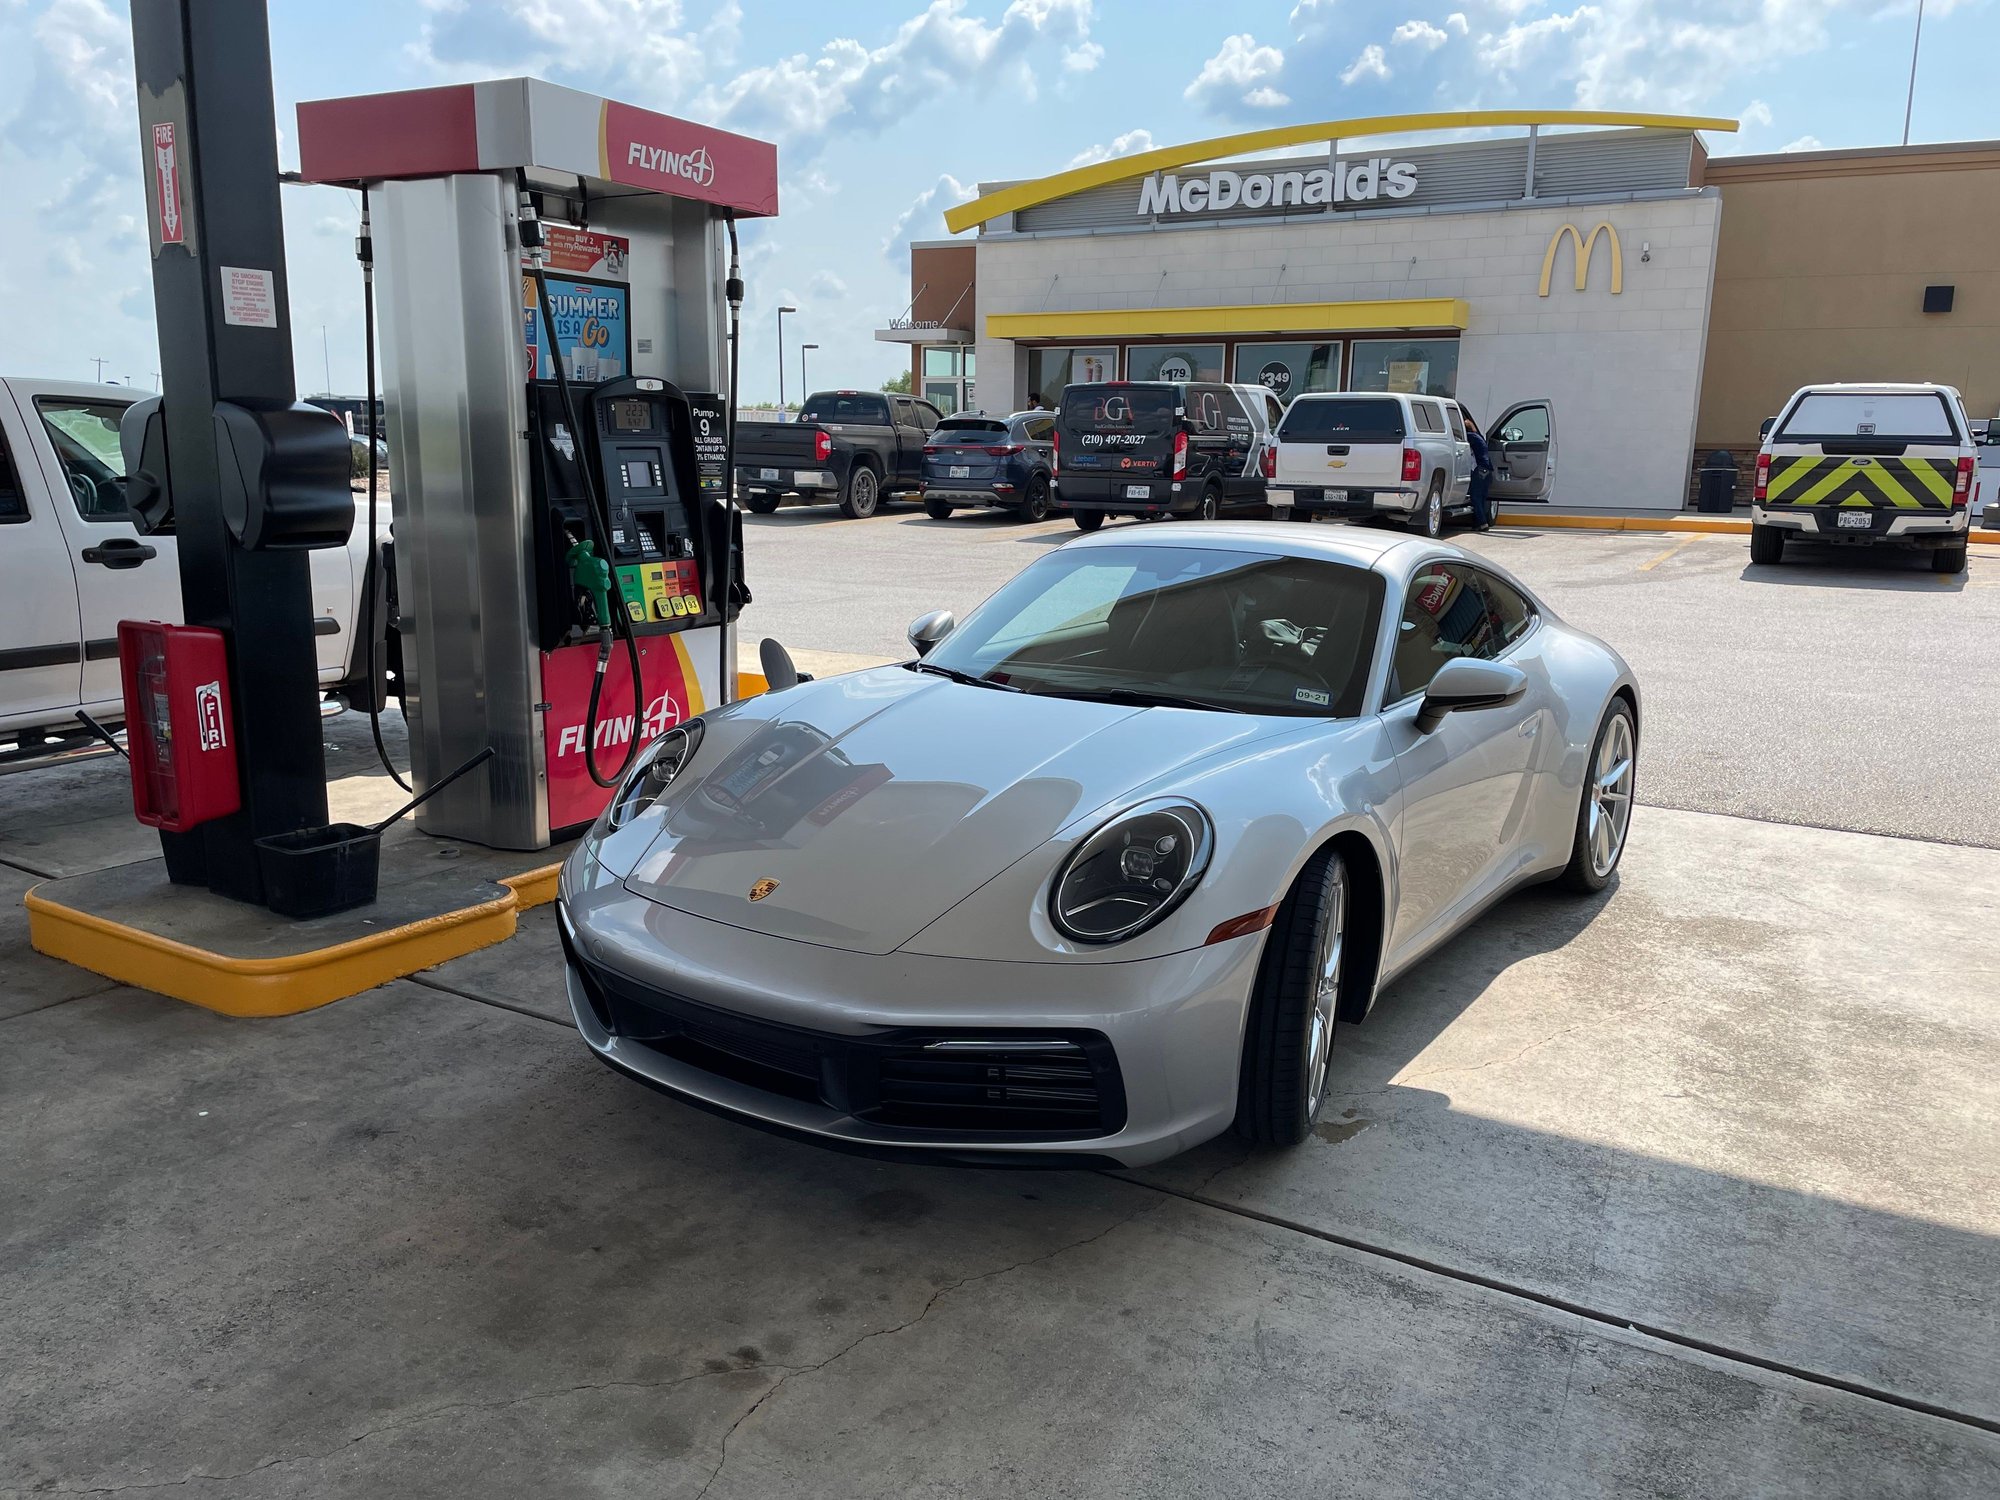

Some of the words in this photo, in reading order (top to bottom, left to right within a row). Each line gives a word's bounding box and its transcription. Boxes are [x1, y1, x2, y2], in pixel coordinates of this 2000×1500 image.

[155, 126, 173, 144] FIRE
[163, 152, 174, 232] EXTINGUISHER
[1138, 158, 1418, 215] McDonald's
[575, 234, 588, 244] BUY
[589, 237, 594, 245] 2
[563, 242, 601, 254] myRewards
[548, 294, 619, 319] SUMMER
[557, 320, 571, 335] IS
[573, 320, 581, 335] A
[888, 318, 938, 329] Welcome
[611, 404, 616, 412] $
[693, 408, 715, 419] Pump
[700, 419, 710, 436] 9
[1081, 435, 1103, 446] (210)
[1105, 435, 1146, 445] 497-2027
[661, 604, 669, 612] 87
[674, 602, 684, 610] 89
[688, 600, 697, 608] 93
